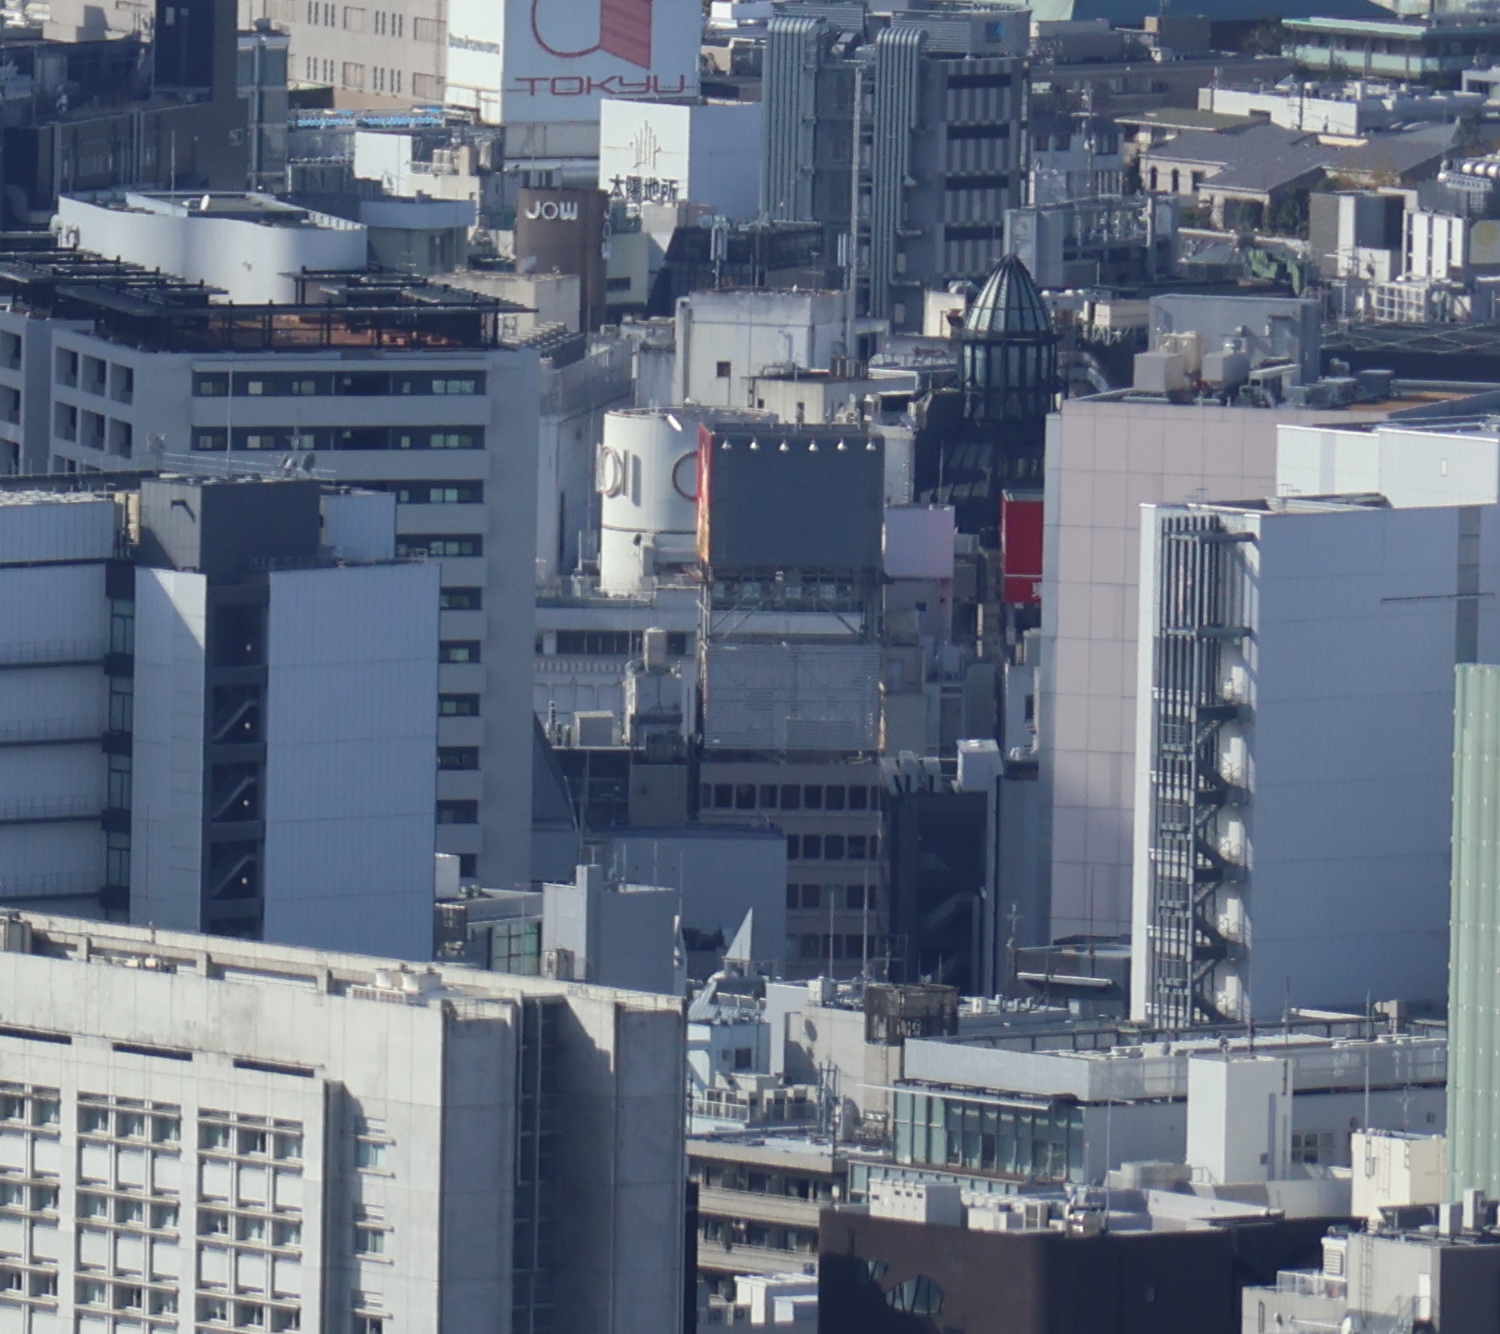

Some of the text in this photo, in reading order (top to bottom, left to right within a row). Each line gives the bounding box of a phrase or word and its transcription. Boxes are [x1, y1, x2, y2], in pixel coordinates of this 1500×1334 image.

[515, 75, 685, 96] TOKYU
[609, 174, 679, 203] 太陽地所
[525, 201, 578, 221] JOW
